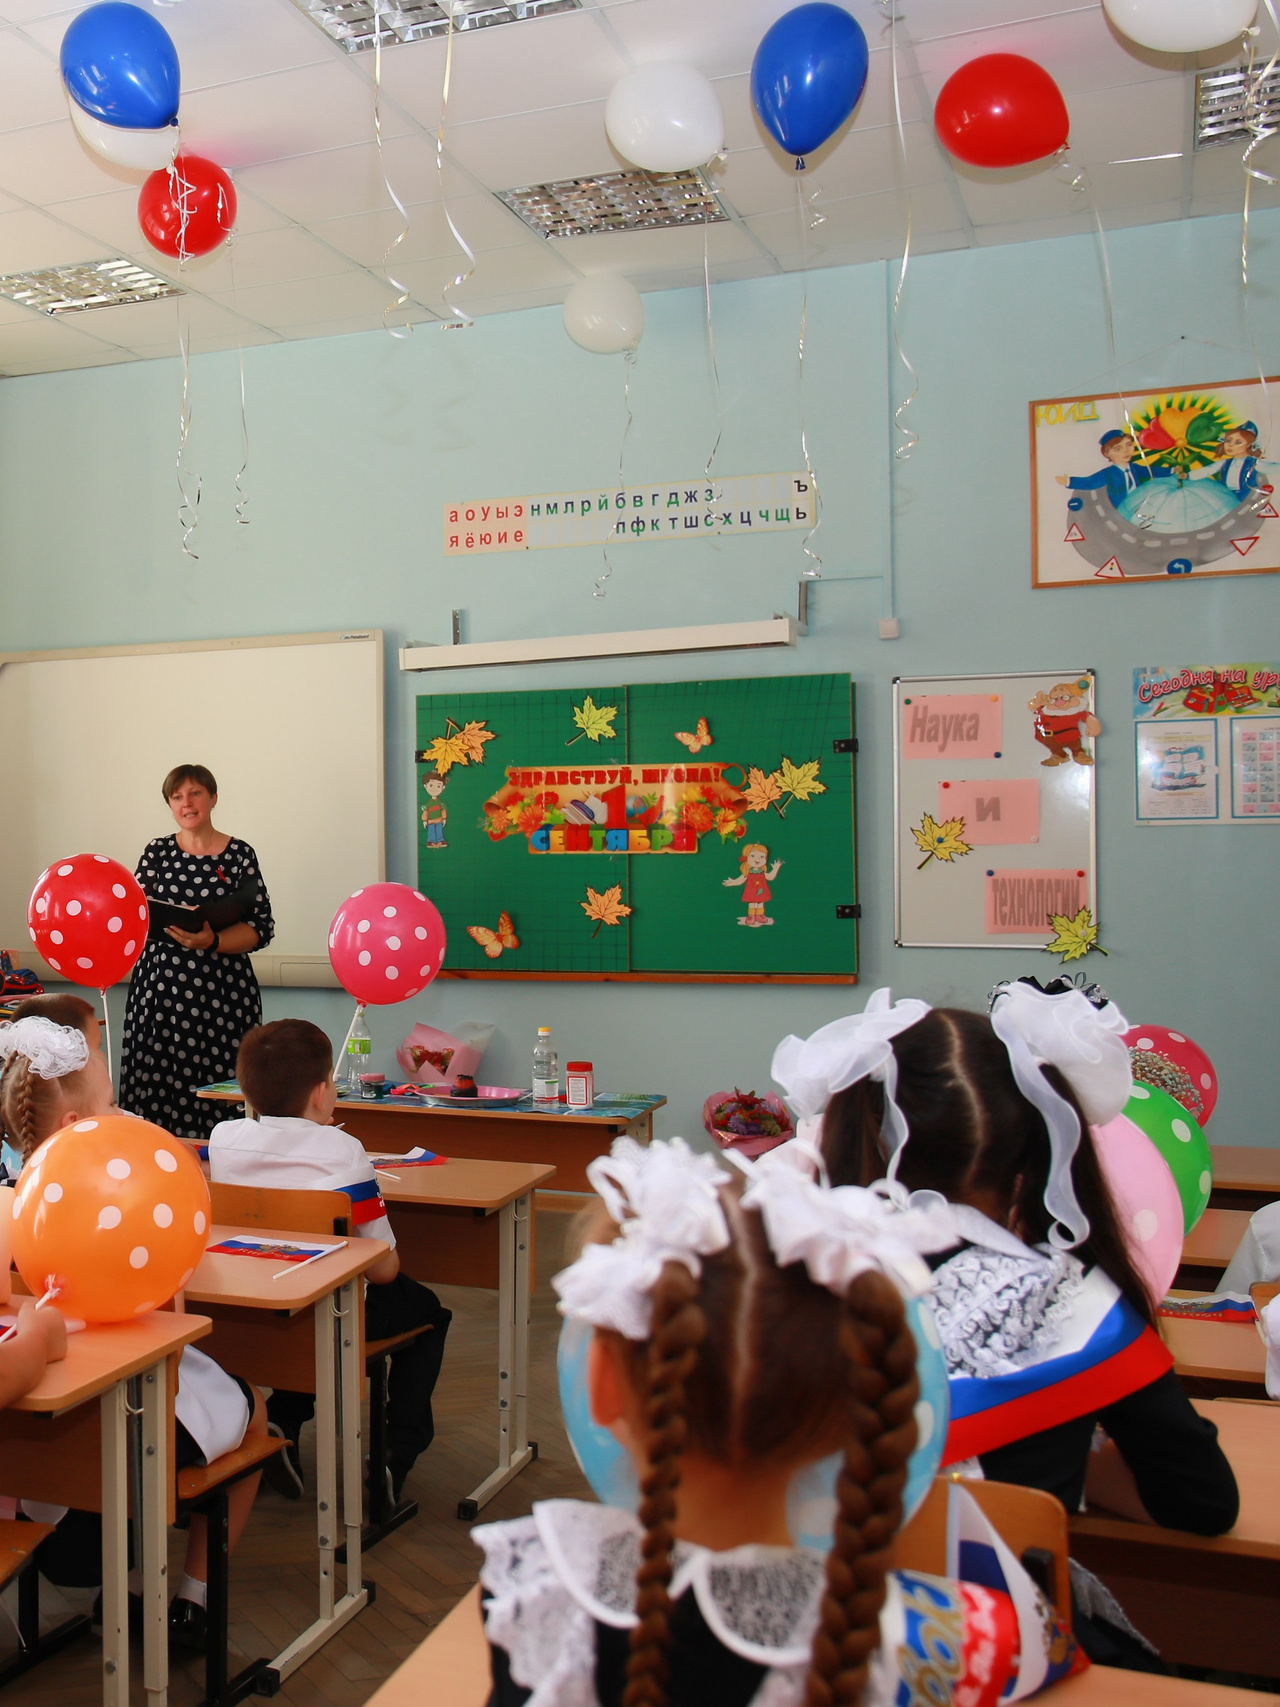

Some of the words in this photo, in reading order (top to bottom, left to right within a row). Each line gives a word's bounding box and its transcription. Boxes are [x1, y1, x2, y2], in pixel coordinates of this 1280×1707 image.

[1138, 669, 1215, 702] Сегодня
[1221, 669, 1246, 683] на
[908, 705, 981, 753] Наука
[508, 767, 638, 788] ЗДРАВСТВУЙ,
[642, 767, 721, 784] ШКОЛА!
[601, 783, 627, 829] 1
[530, 824, 697, 851] СЕНТЯБРЯ
[992, 877, 1080, 926] технологии
